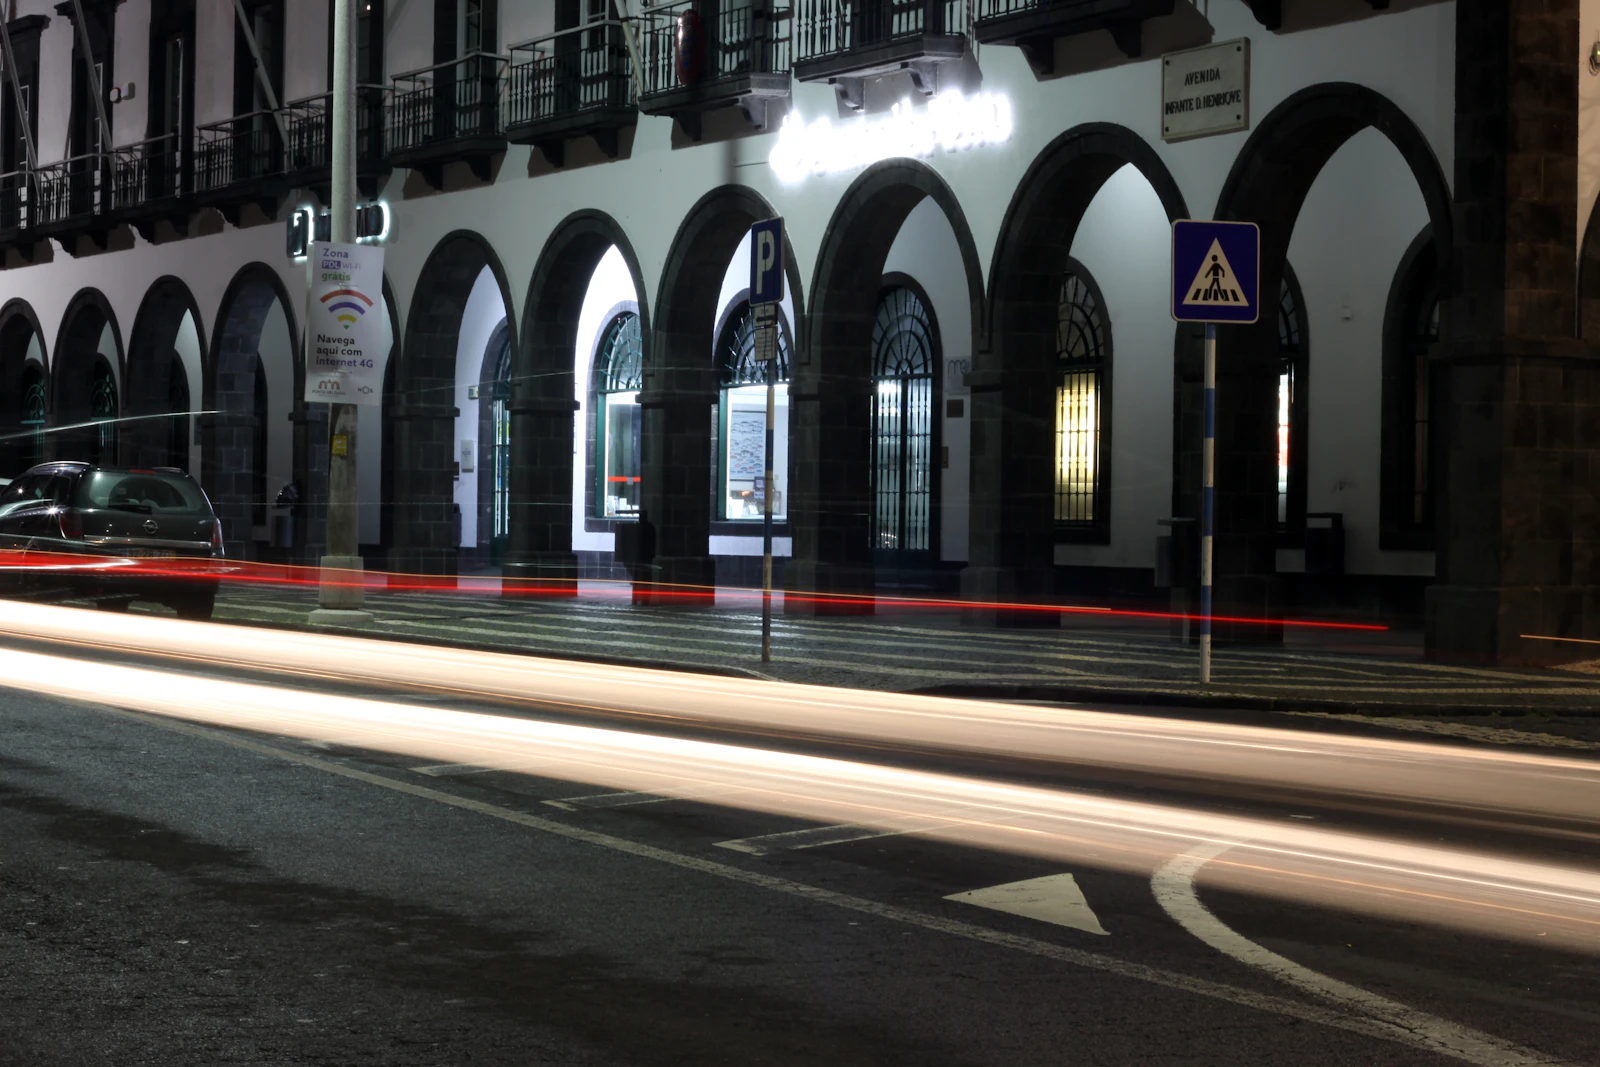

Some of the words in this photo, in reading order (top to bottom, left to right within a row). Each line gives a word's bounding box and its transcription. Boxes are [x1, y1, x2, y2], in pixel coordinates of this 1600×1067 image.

[1184, 68, 1221, 86] AVENIDA
[1165, 98, 1194, 115] INFANTE
[1196, 97, 1202, 110] D.
[323, 248, 348, 258] Zona
[756, 230, 775, 295] P
[321, 271, 351, 282] grátis
[317, 334, 355, 347] Navega
[316, 346, 338, 356] aqui
[341, 348, 362, 356] com
[316, 356, 357, 367] internet
[359, 359, 374, 368] 4G
[357, 385, 374, 395] NOS
